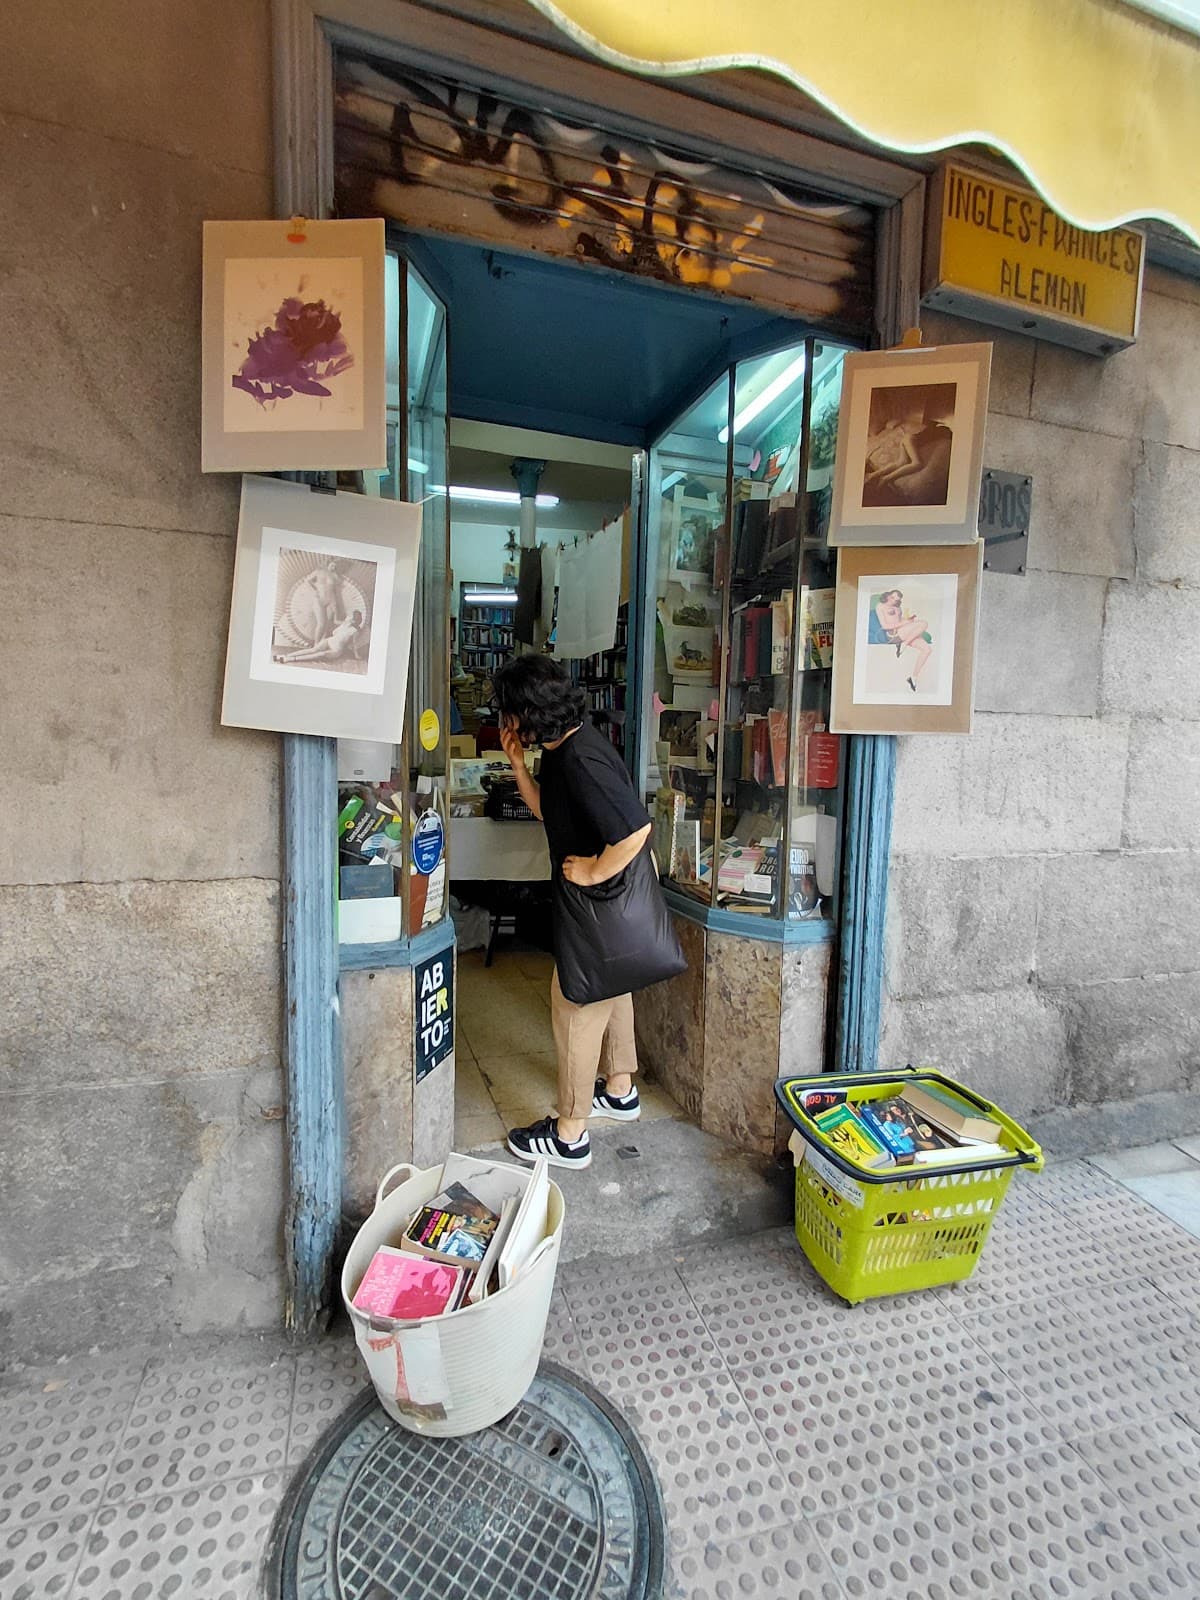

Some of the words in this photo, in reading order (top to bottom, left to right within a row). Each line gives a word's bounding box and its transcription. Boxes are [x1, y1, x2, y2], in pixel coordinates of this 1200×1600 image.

[1000, 258, 1087, 317] ALEMAN
[421, 961, 444, 999] AB
[421, 987, 449, 1028] IER
[420, 1019, 444, 1056] TO
